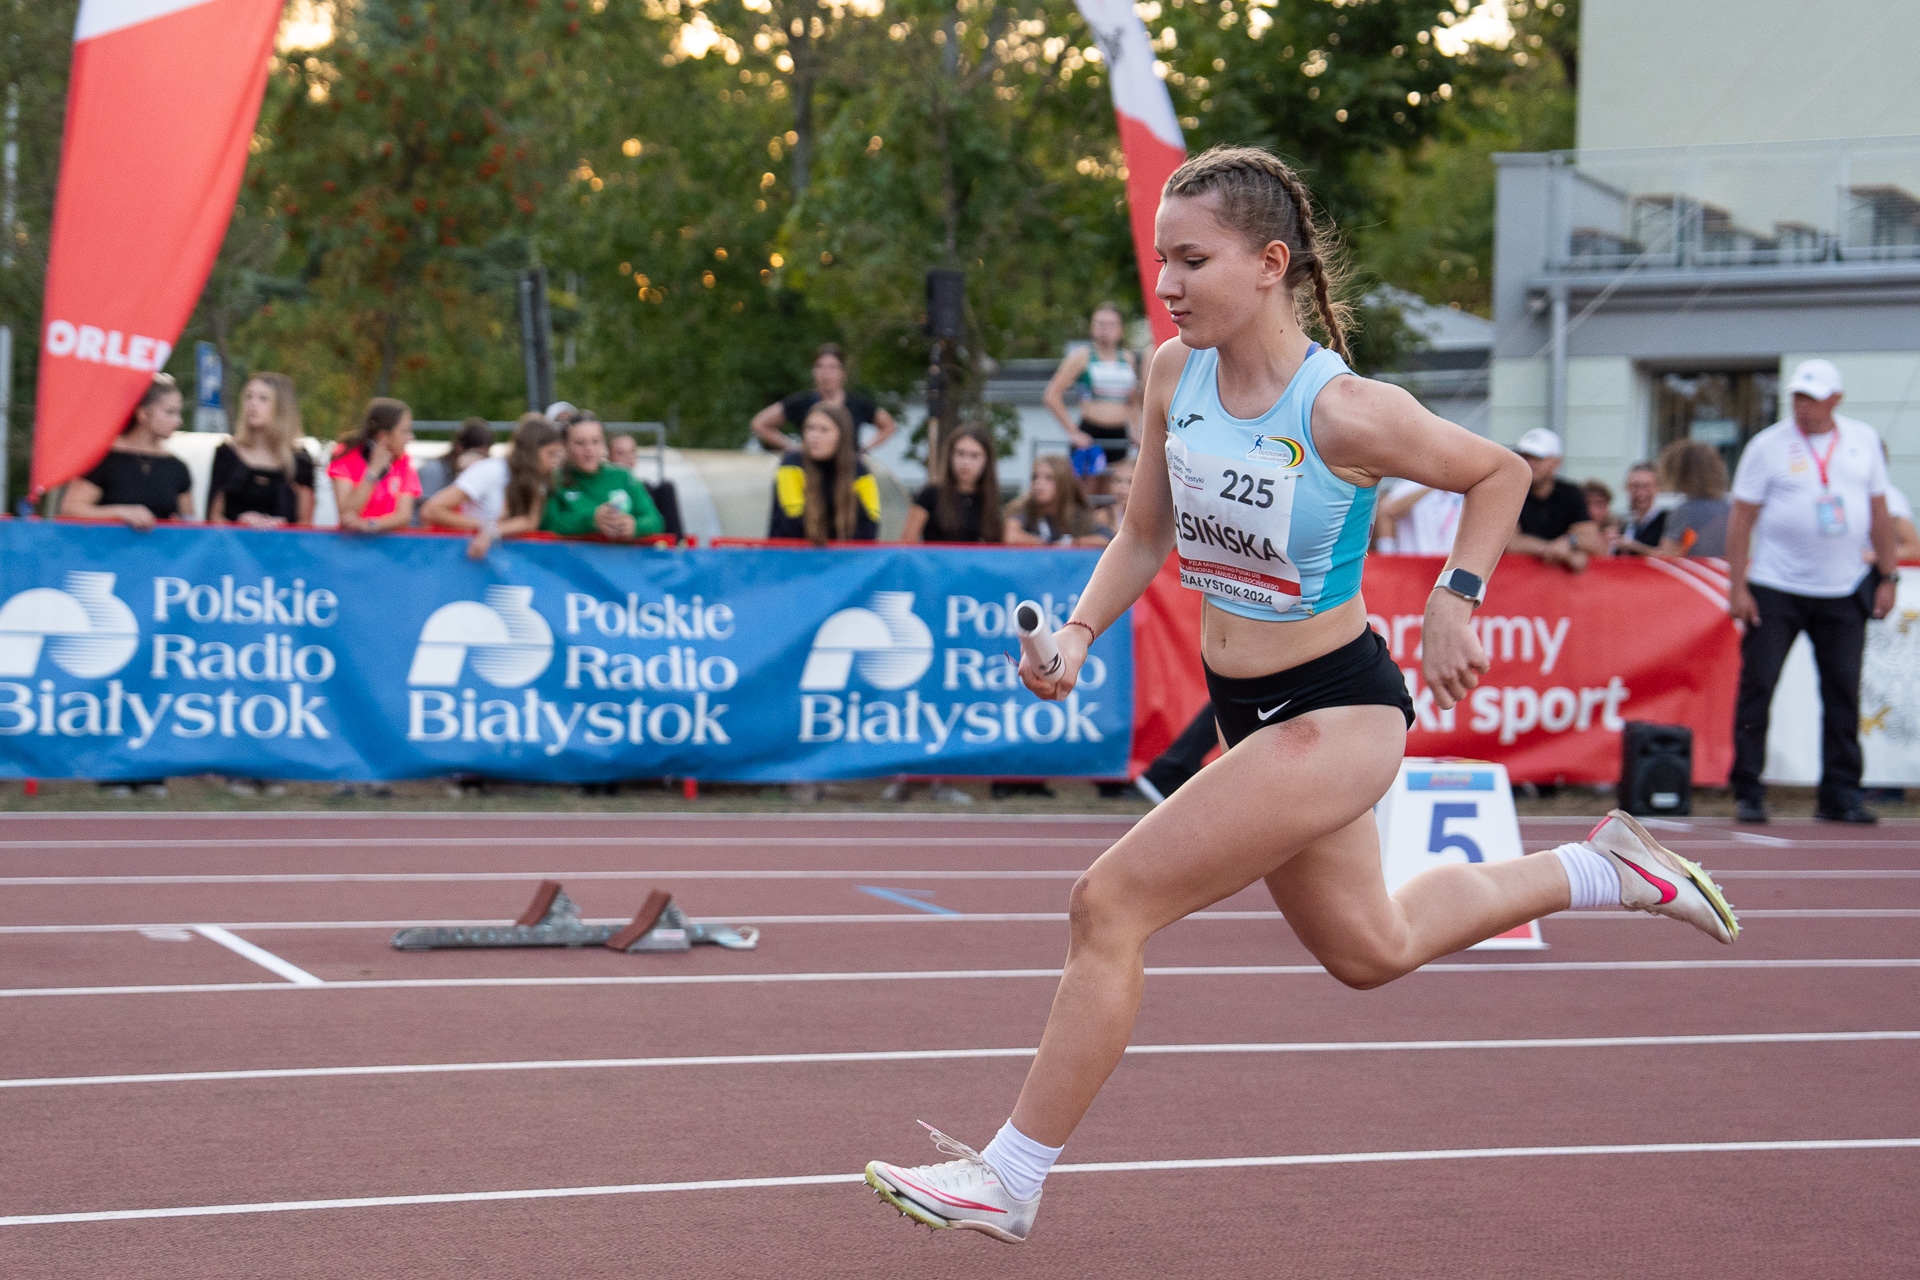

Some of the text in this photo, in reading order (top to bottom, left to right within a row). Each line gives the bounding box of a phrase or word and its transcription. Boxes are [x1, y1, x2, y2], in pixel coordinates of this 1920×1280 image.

[1220, 469, 1275, 509] 225
[1180, 572, 1273, 605] BIAŁYSTOK 2024
[1188, 559, 1202, 567] PZLA
[1235, 568, 1251, 577] Polski
[1215, 570, 1237, 581] JANUSZA
[1238, 576, 1280, 591] KUSOCIŃSKIEGO
[152, 574, 339, 628] Polskie
[565, 591, 736, 641] Polskie
[945, 591, 1080, 639] Polki
[150, 632, 337, 683] Radio
[564, 645, 739, 692] Radio
[943, 646, 1108, 692] Rao
[0, 679, 331, 750] Białystok
[407, 687, 732, 757] Białystok
[797, 689, 1105, 755] Białystok
[1470, 675, 1630, 745] sport
[1427, 801, 1485, 864] 5
